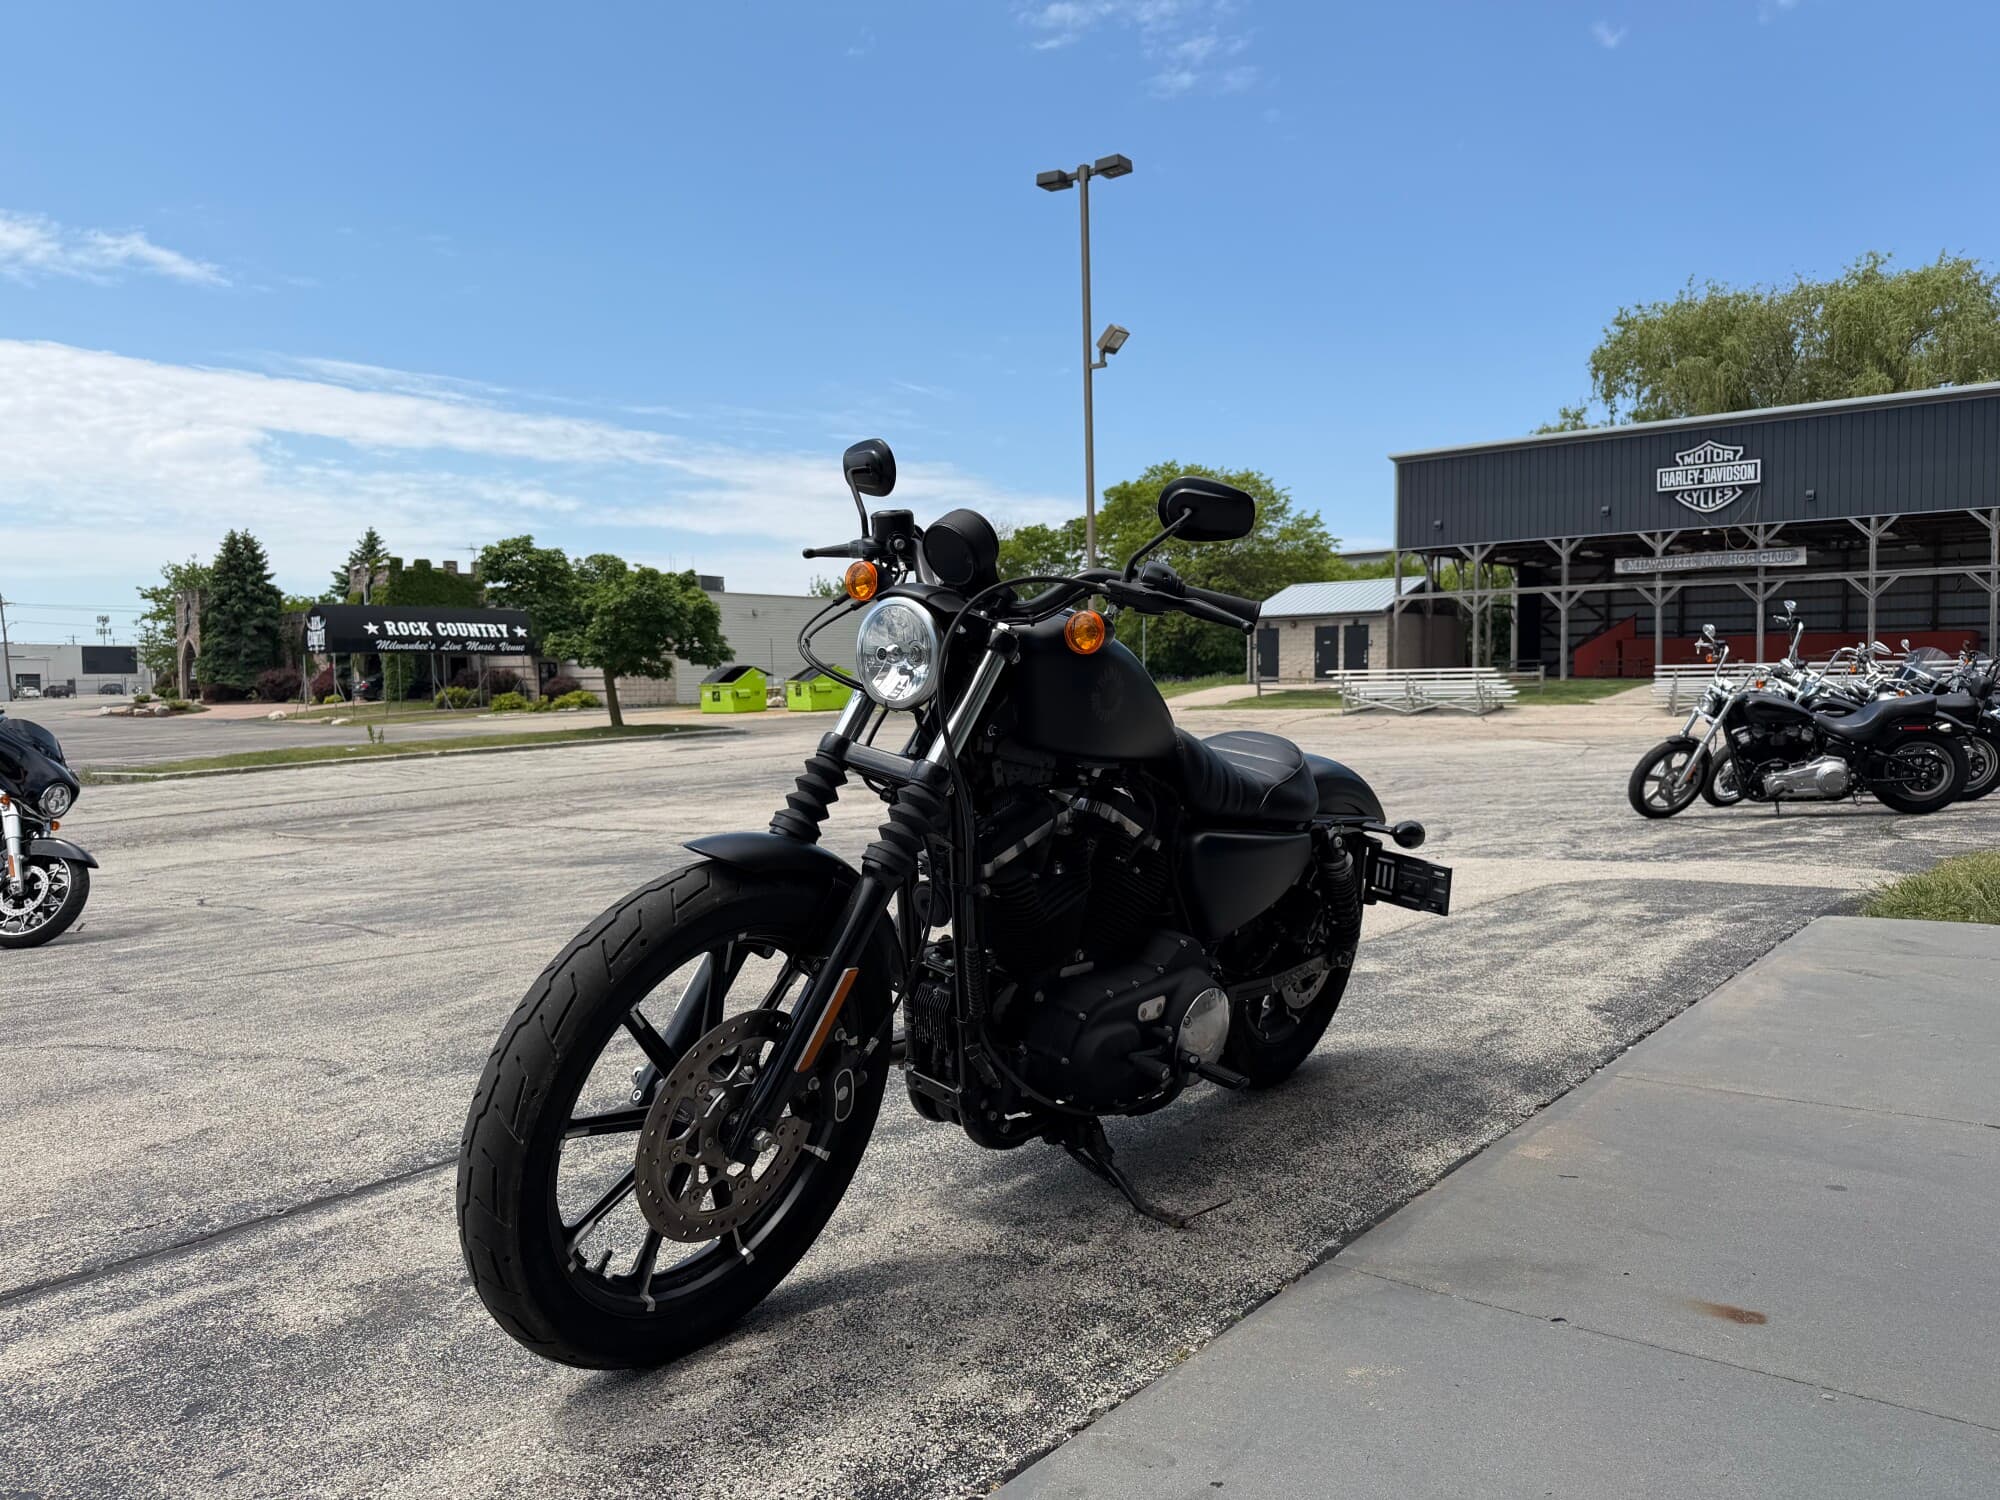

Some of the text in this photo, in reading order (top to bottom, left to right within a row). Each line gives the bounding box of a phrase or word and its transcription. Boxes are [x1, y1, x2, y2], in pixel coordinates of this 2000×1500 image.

[1683, 445, 1735, 465] MOTOR
[1662, 464, 1756, 487] HARLEY-DAVIDSON
[1683, 487, 1734, 508] CYCLES
[1627, 557, 1697, 571] MILWAUKEE
[1728, 553, 1755, 565] HOG
[1759, 551, 1793, 563] CLUB
[384, 620, 509, 638] ROCK COUNTRY
[375, 639, 526, 651] Milwaukee's Live Music Venue
